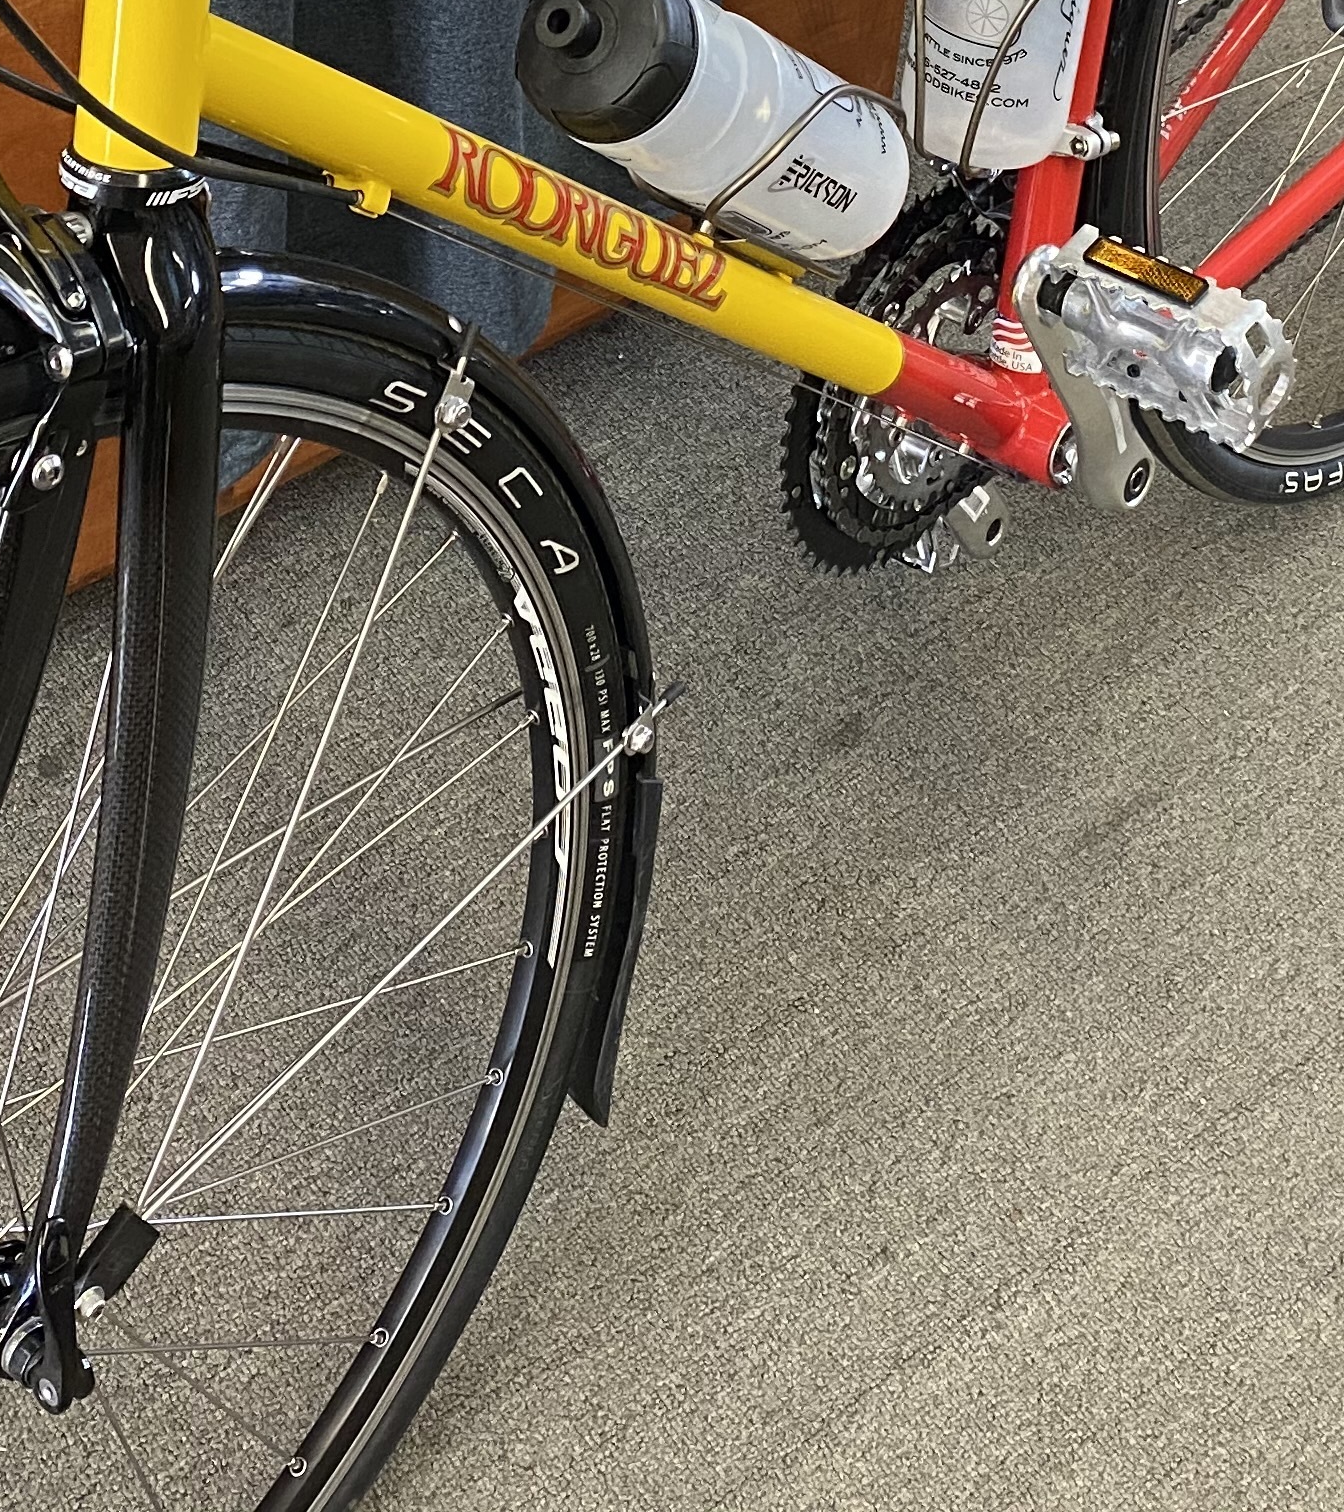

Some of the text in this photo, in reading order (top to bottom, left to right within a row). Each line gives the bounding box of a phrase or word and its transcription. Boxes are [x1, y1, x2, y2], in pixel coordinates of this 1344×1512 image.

[923, 33, 1028, 67] ATTLE SINCE 973
[776, 154, 858, 213] ERICKSON
[430, 123, 729, 311] RODRIGUEZ
[1011, 361, 1033, 371] USA
[598, 689, 609, 706] PSI
[599, 709, 612, 734] MAX
[600, 804, 612, 832] FLAT
[592, 838, 610, 909] PROTECTION
[584, 914, 601, 958] SYSTEM
